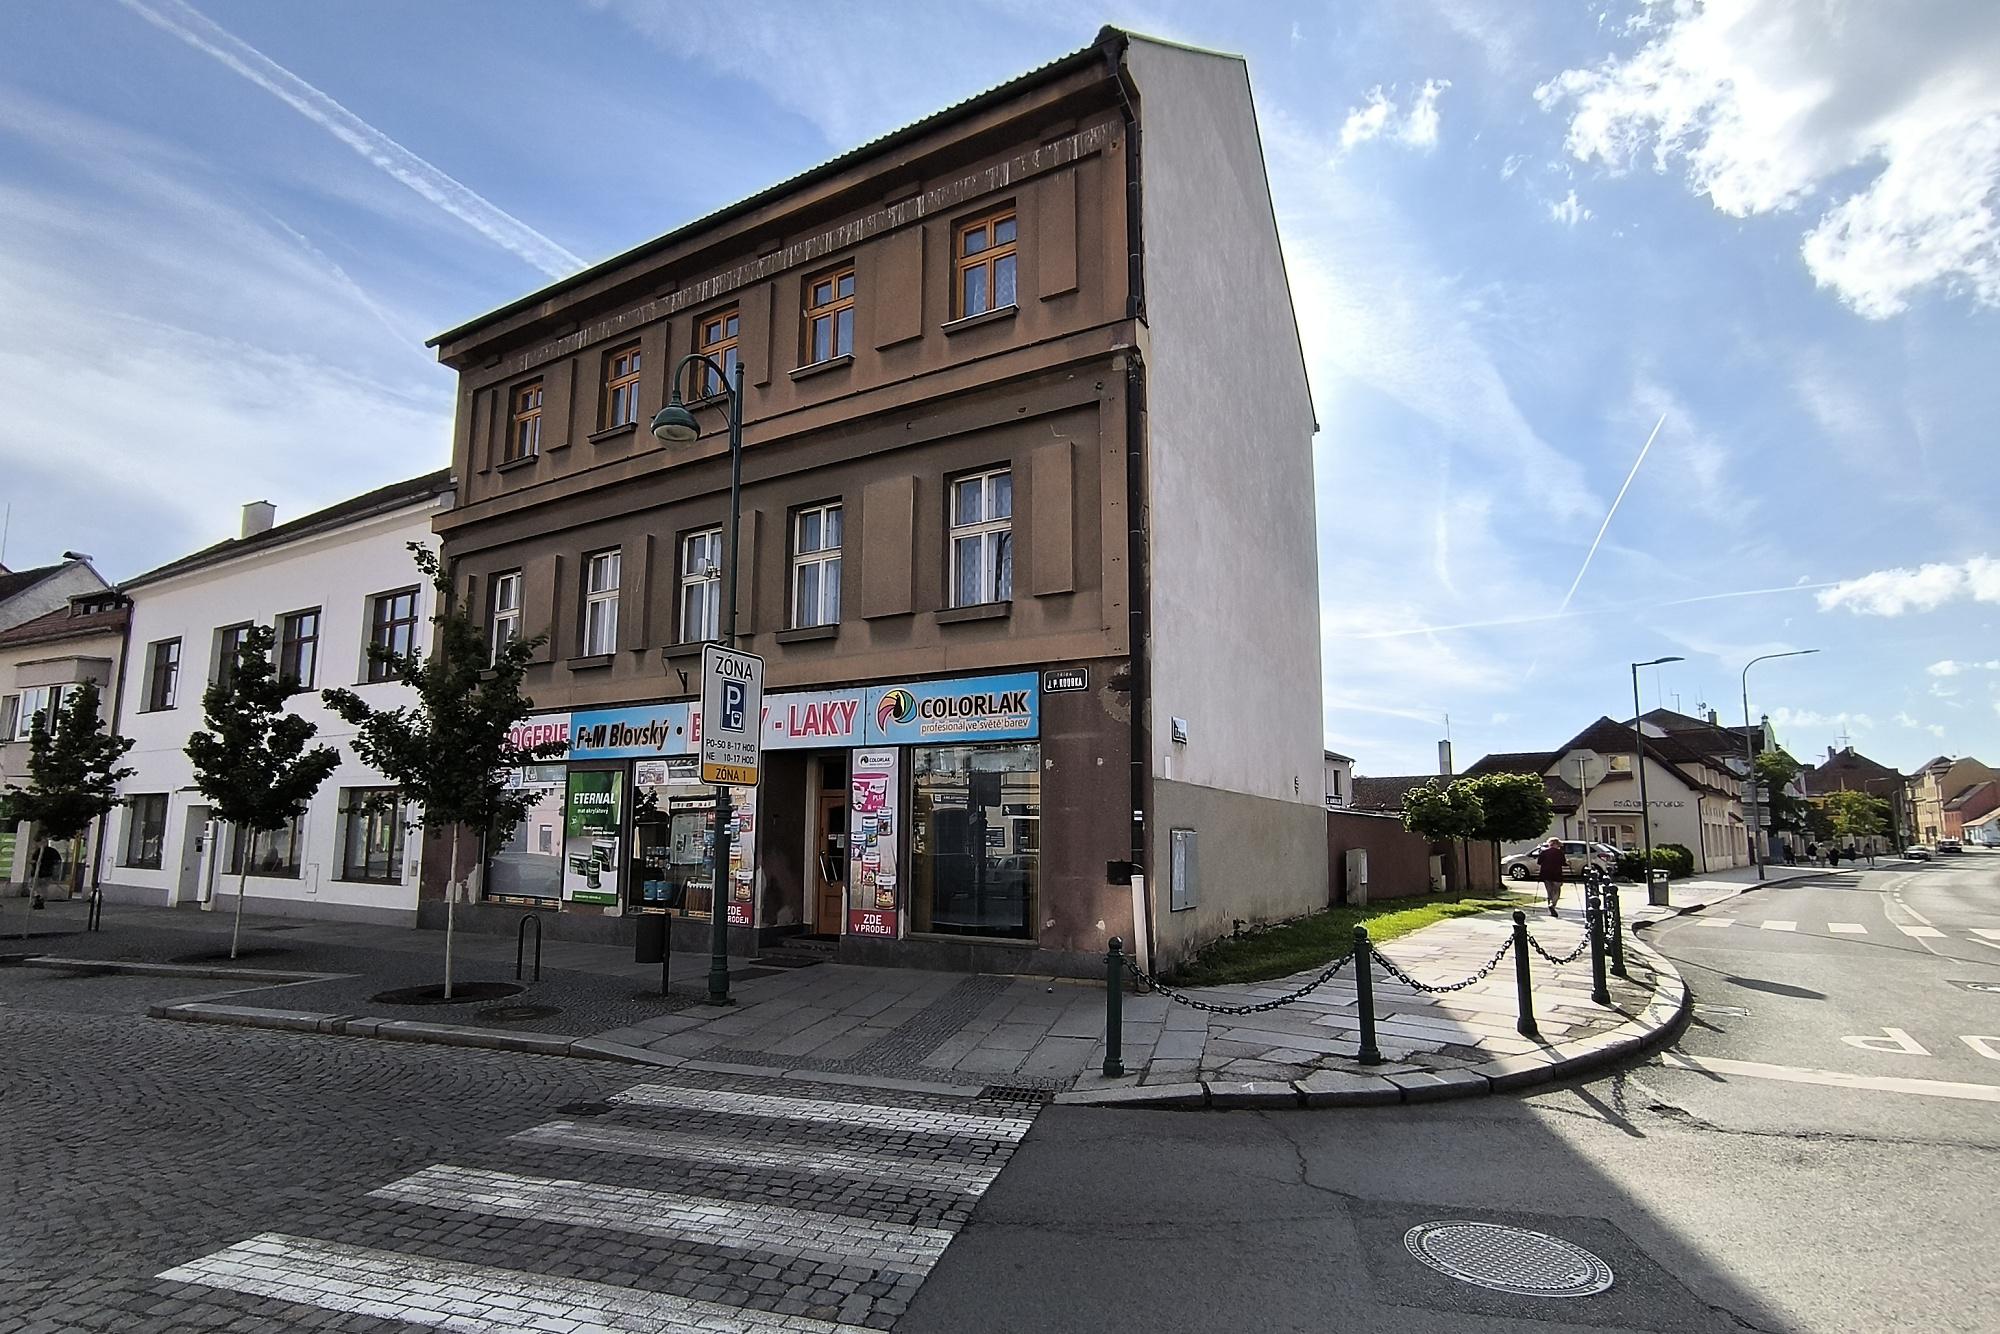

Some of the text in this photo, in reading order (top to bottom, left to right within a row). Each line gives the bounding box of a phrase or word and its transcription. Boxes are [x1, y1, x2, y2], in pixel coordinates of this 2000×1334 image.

[715, 655, 753, 681] ZÓNA
[921, 692, 1027, 718] COLORLAK
[790, 701, 857, 737] LAKY
[921, 717, 1028, 734] profesionál ve světě barev
[576, 724, 607, 749] F+M
[609, 719, 668, 750] Blovský
[706, 738, 726, 749] PO-SO
[727, 741, 741, 751] 8-17
[706, 751, 715, 760] NE
[724, 753, 741, 762] 10-17
[715, 766, 746, 781] ZÓNA 1
[573, 792, 616, 805] ETERNAL
[863, 914, 882, 925] ZDE
[854, 924, 891, 934] V PRODEJI
